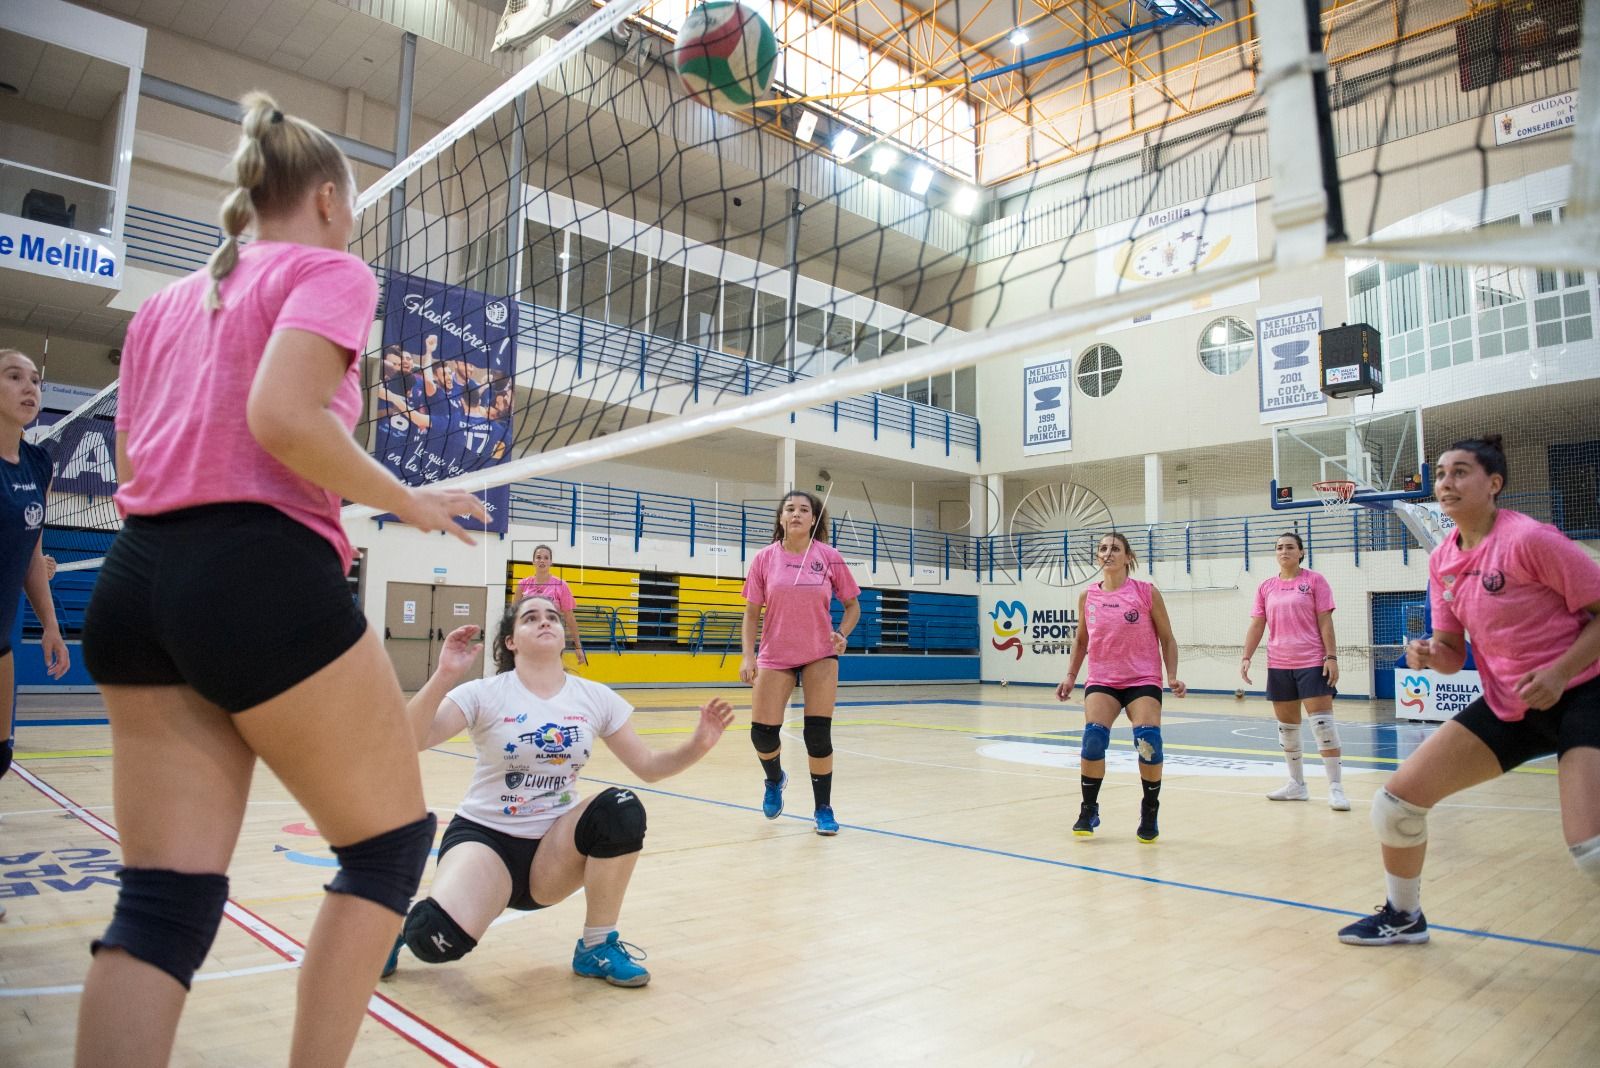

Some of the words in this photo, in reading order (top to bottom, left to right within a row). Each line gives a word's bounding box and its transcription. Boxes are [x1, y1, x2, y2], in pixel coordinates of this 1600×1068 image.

[1530, 95, 1572, 114] CIUDAD
[1148, 207, 1191, 227] Melilla
[19, 233, 115, 278] Melilla
[403, 293, 491, 353] Gladiadores
[1264, 313, 1314, 331] MELILLA
[1263, 321, 1317, 340] BALONCESTO
[1029, 364, 1065, 377] MELILLA
[1028, 371, 1067, 385] BALONCESTO
[1280, 372, 1303, 385] 2001
[1278, 384, 1306, 397] COPA
[1267, 391, 1319, 407] PRINCIPE
[1038, 413, 1055, 423] 1999
[1029, 430, 1066, 441] PRINCIPE
[1037, 424, 1058, 433] COPA
[463, 431, 489, 455] 17
[1032, 610, 1079, 623] MELILL
[1032, 640, 1071, 655] CAPIT
[1436, 684, 1480, 693] MELILLA
[1436, 694, 1472, 702] SPORT
[1436, 703, 1467, 711] CAPIT
[525, 773, 567, 791] CIVITAS
